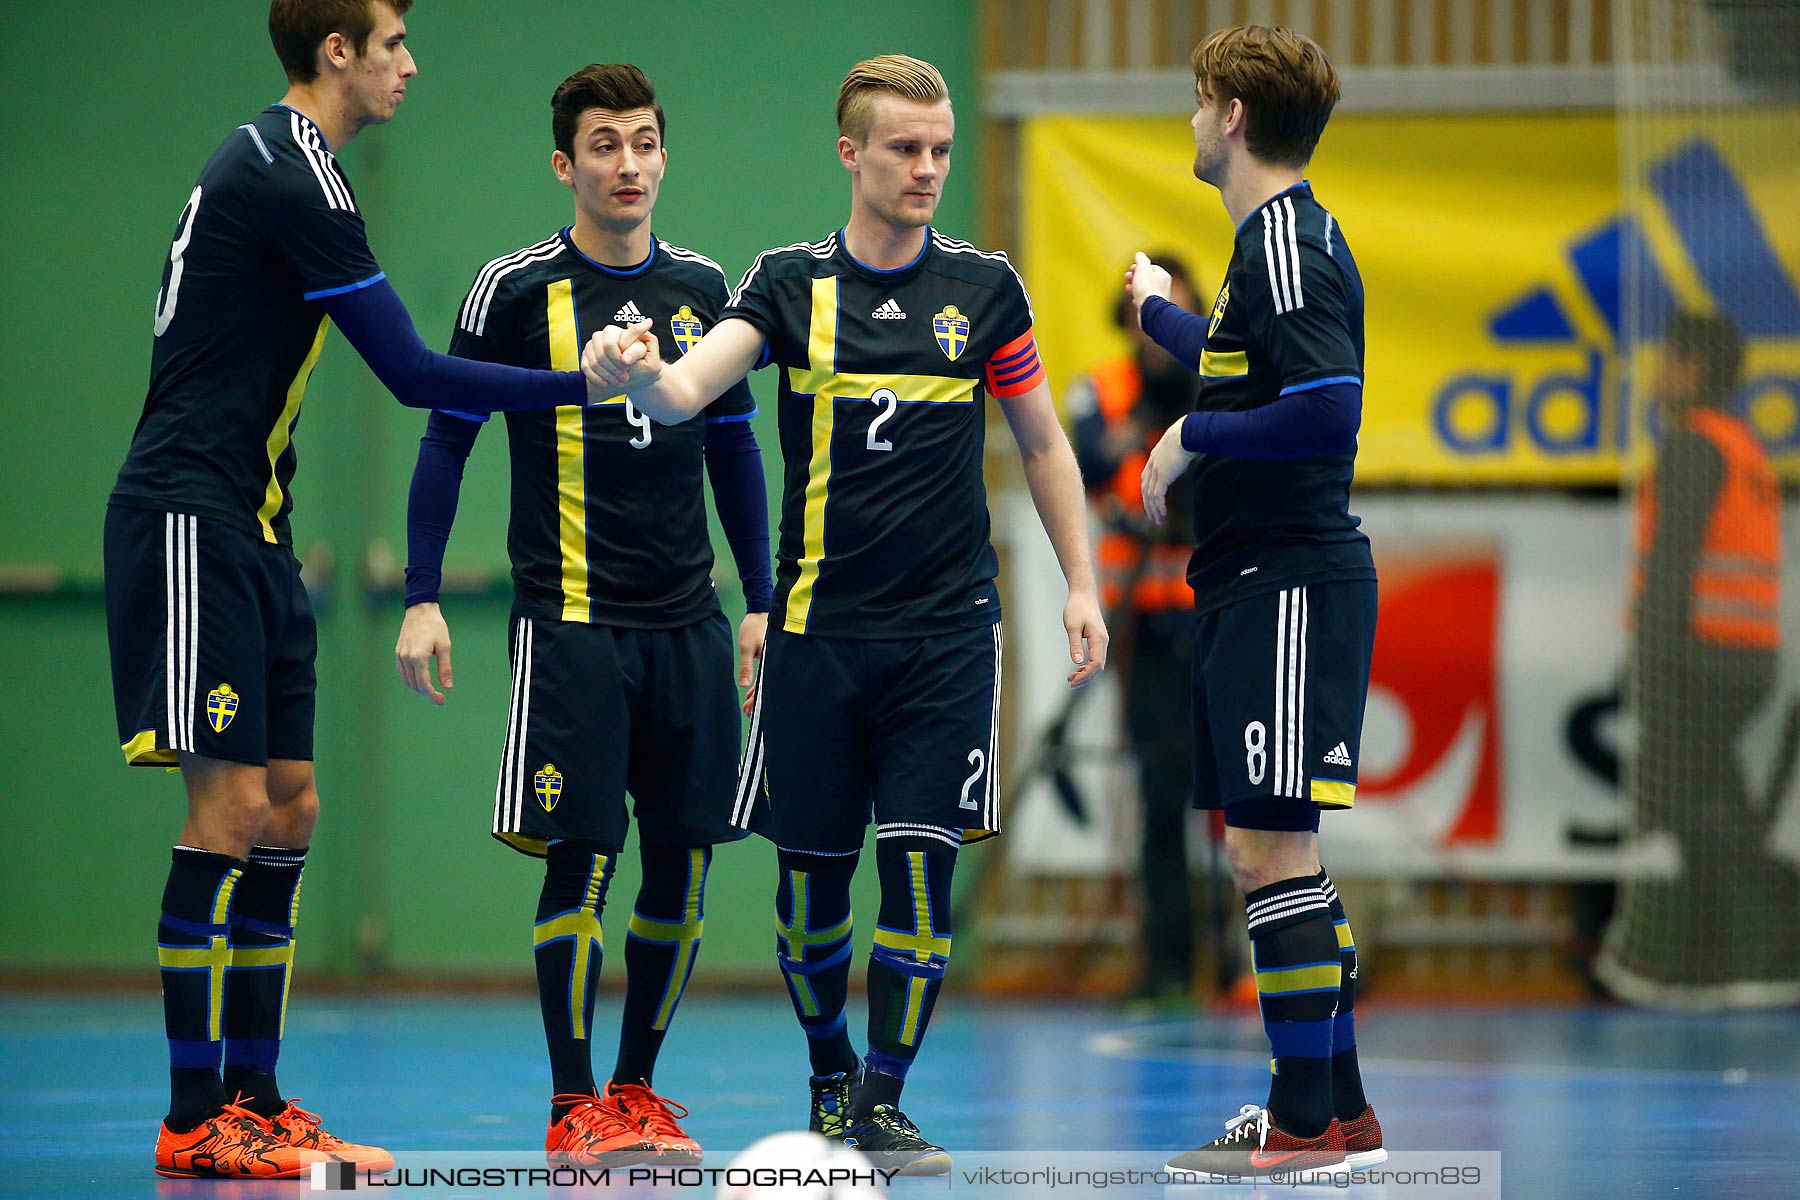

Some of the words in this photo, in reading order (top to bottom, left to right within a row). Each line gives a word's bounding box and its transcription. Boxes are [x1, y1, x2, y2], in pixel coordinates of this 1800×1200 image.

[154, 184, 202, 337] 3
[613, 313, 646, 323] adidas
[871, 311, 907, 320] adidas
[625, 396, 653, 450] 9
[866, 388, 898, 452] 2
[958, 748, 985, 811] 2
[1244, 720, 1267, 786] 8
[1323, 754, 1352, 767] adidas
